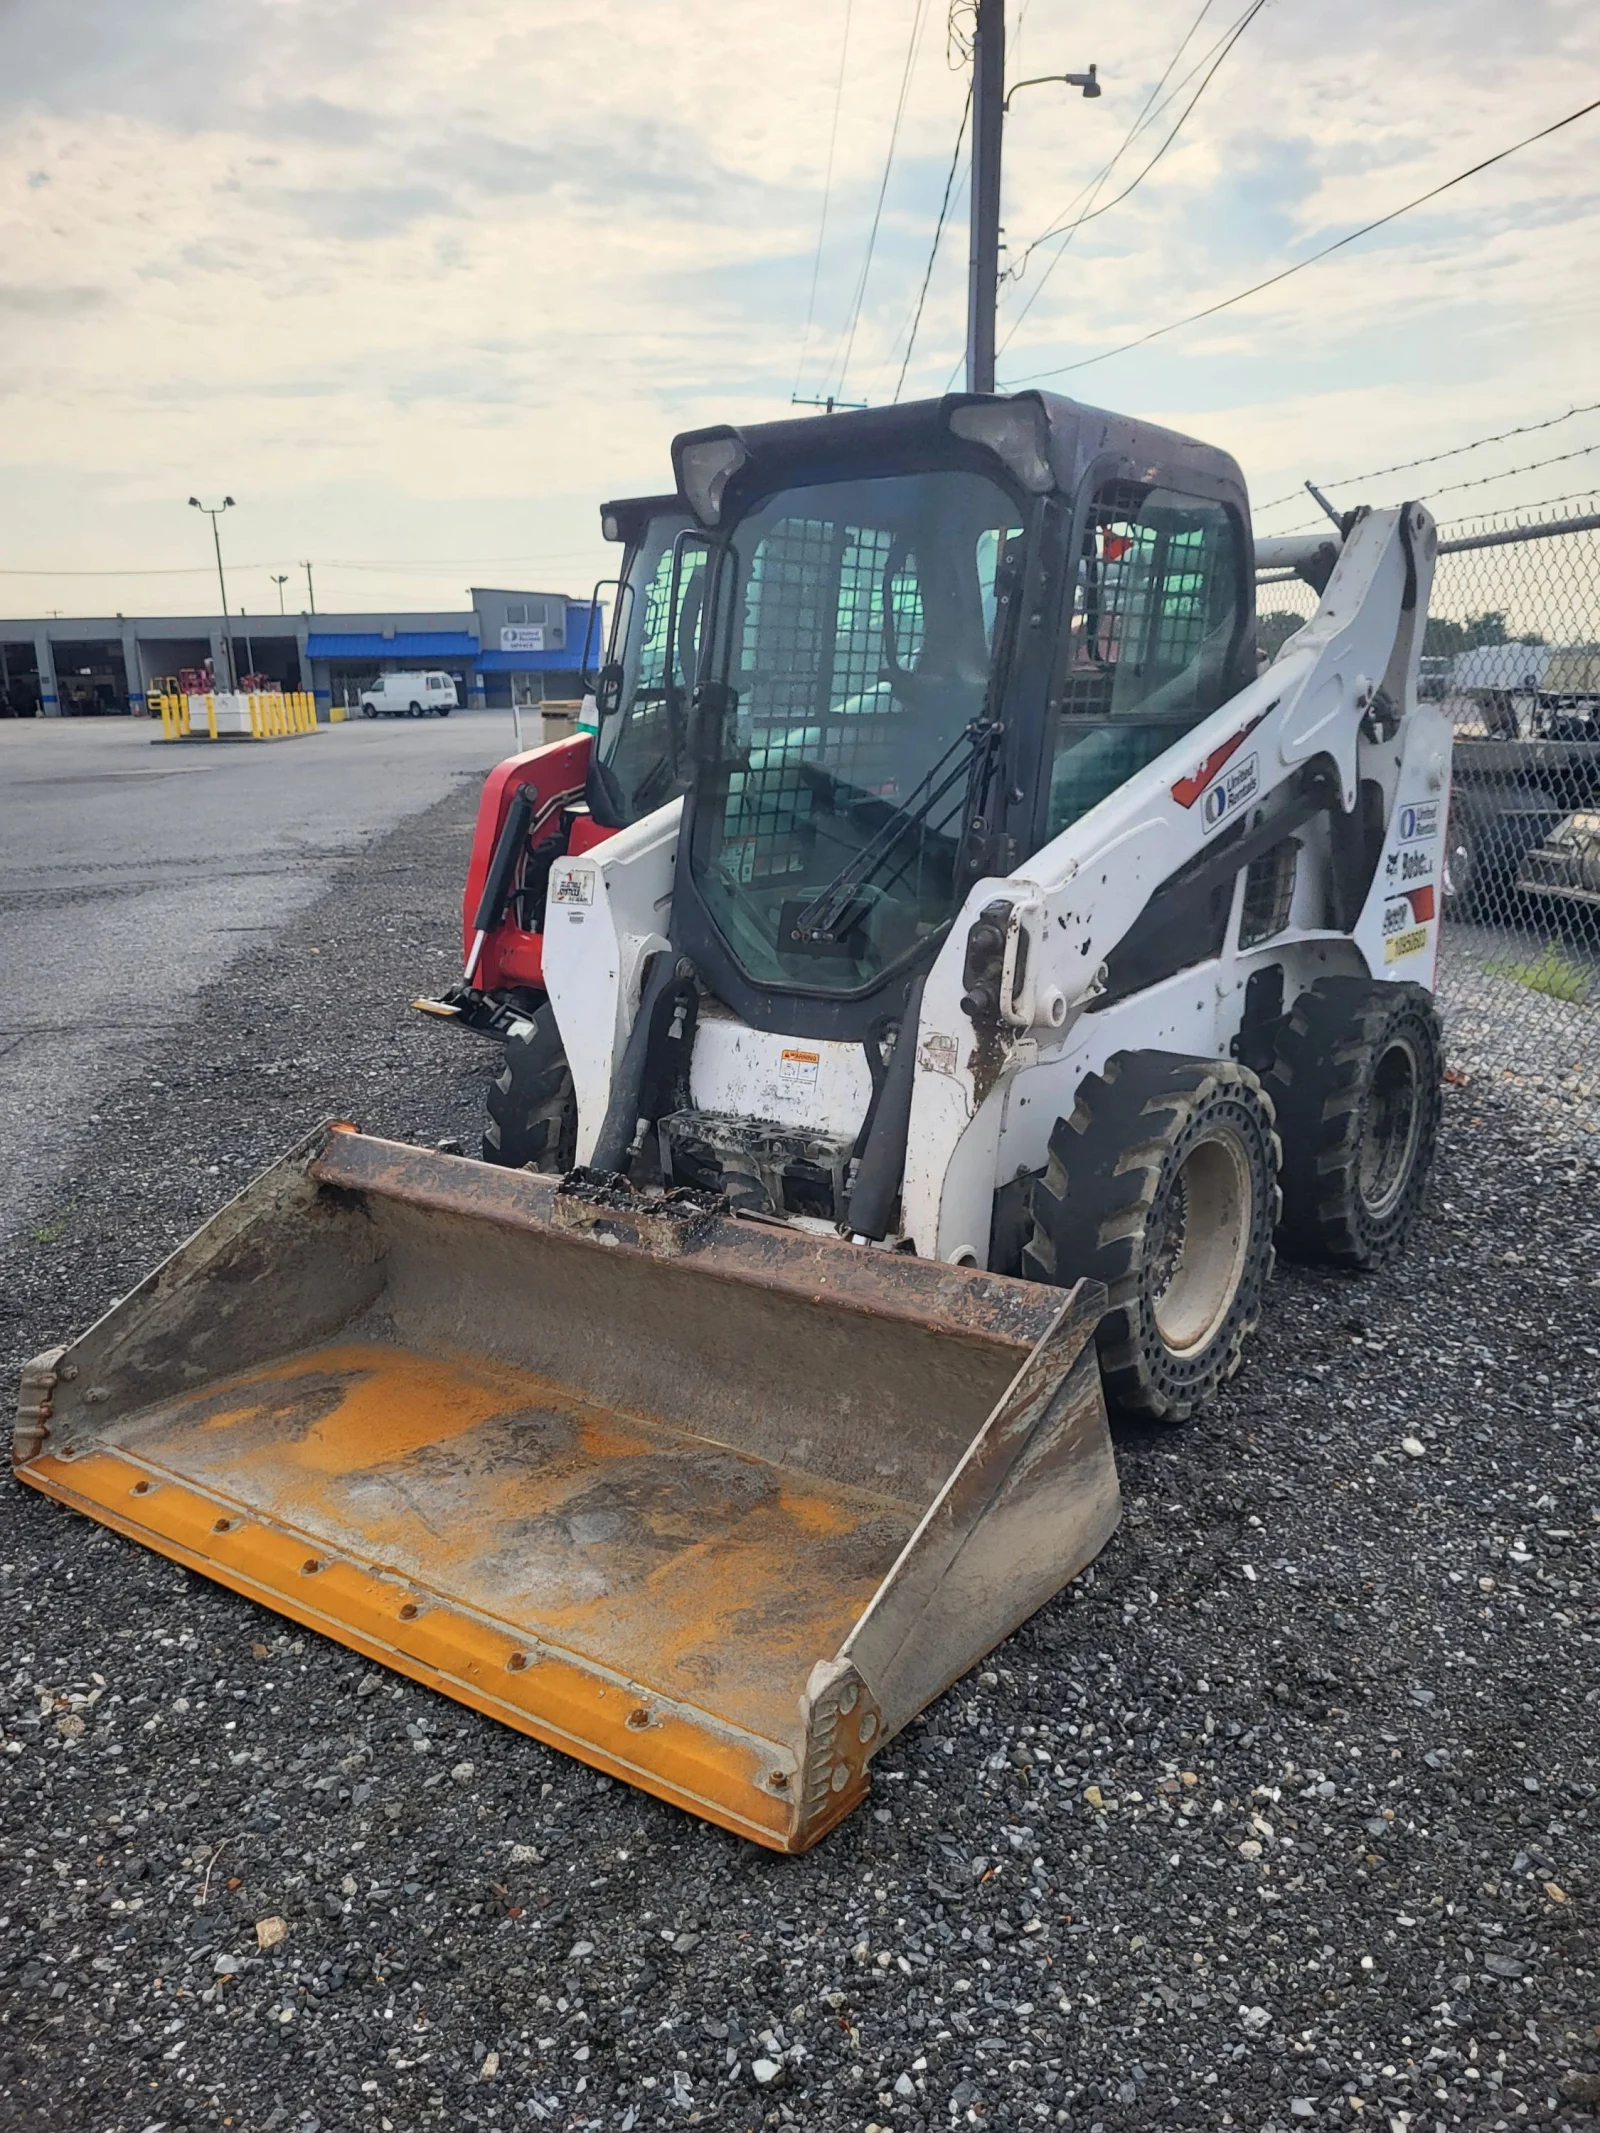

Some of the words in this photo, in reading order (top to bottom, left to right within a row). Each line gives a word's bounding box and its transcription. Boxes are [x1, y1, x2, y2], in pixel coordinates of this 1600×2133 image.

[1226, 760, 1255, 793] United
[1227, 777, 1258, 810] Rentals
[1417, 806, 1437, 821] United
